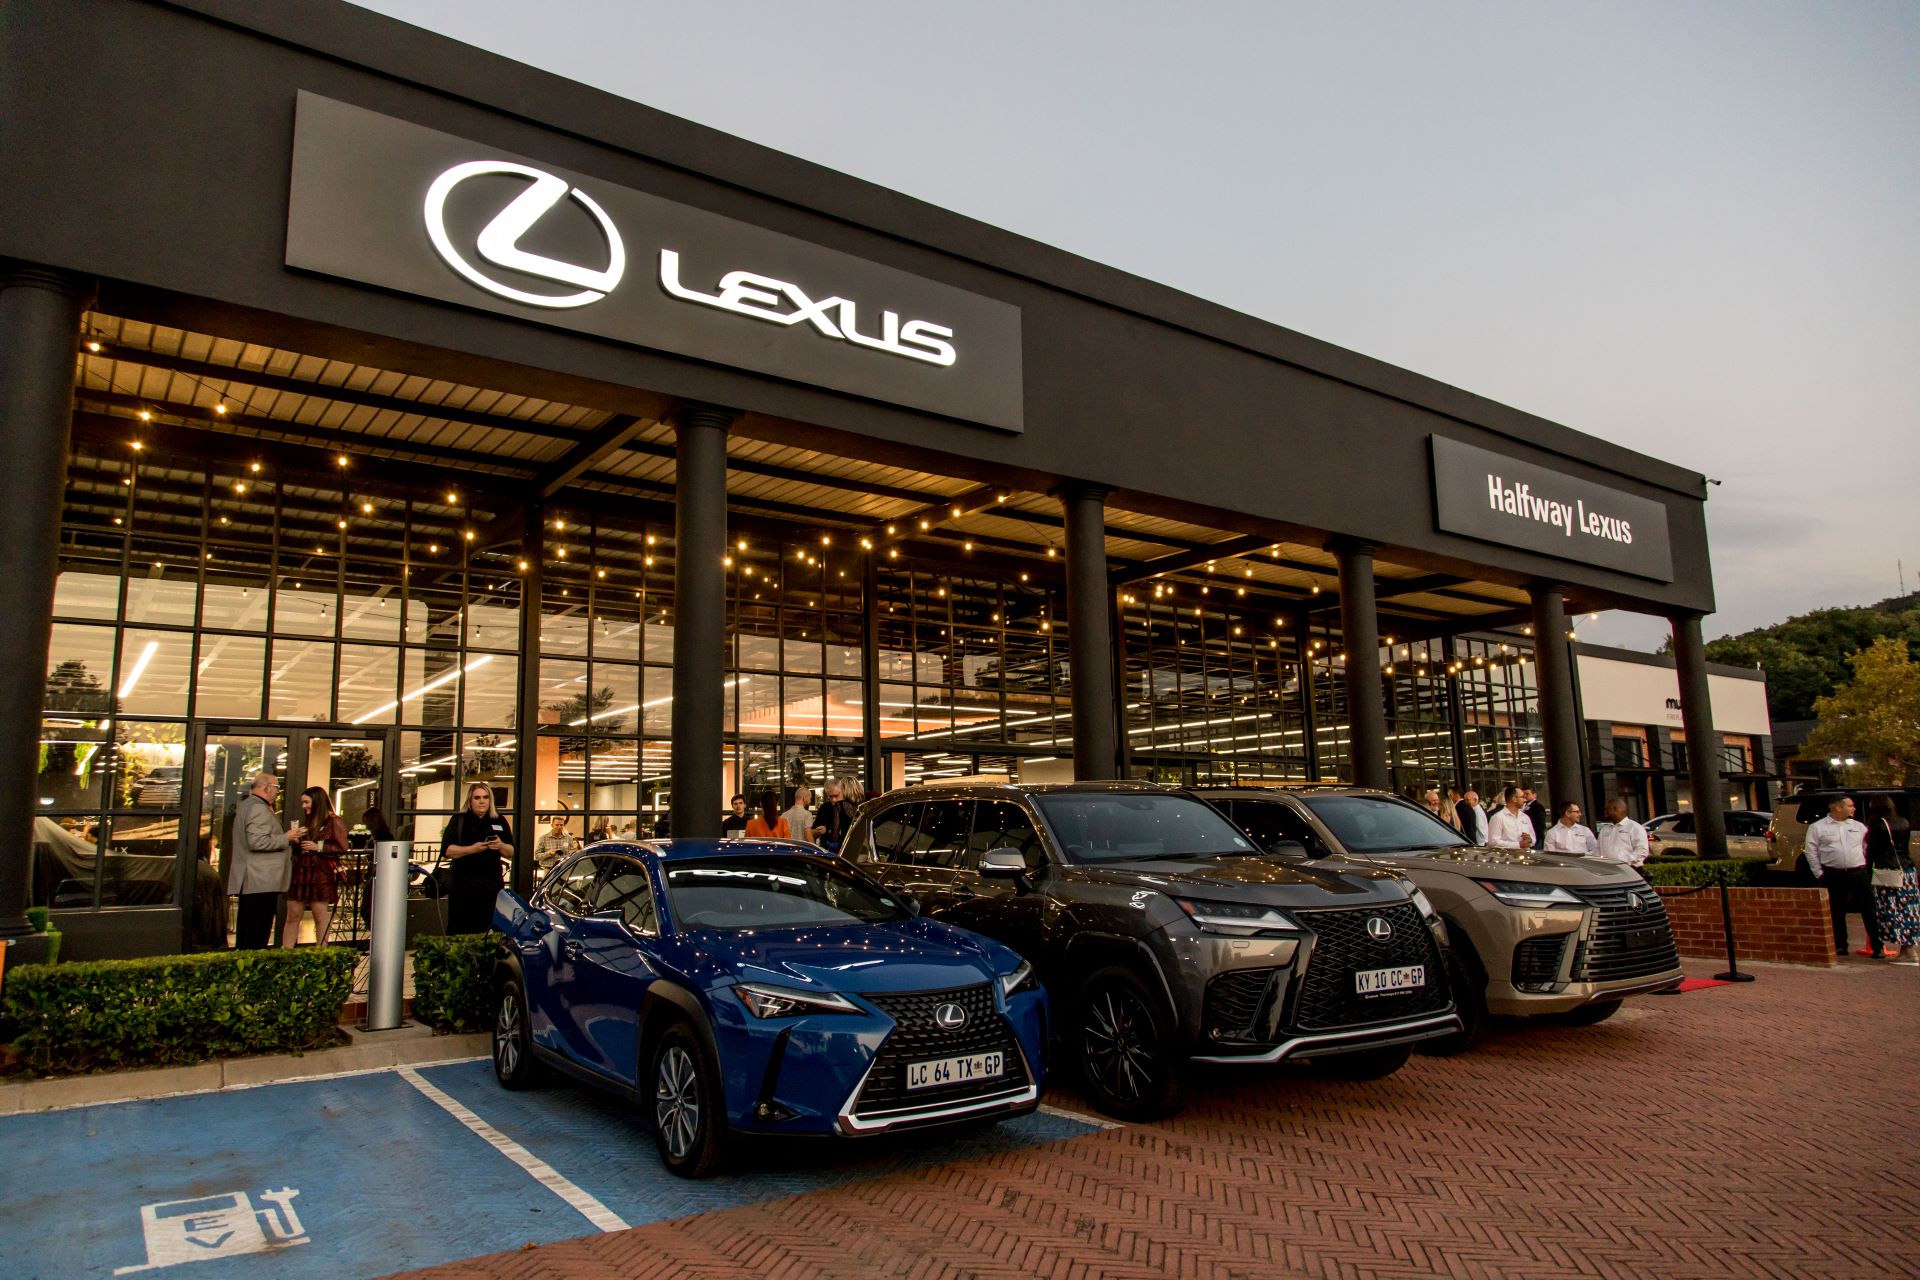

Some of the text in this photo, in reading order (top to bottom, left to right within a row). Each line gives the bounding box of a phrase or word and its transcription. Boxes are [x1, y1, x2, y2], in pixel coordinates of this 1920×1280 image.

[660, 248, 957, 367] LEXUS
[1487, 474, 1633, 544] Halfway Lexus
[1358, 968, 1423, 991] KY 10 CC GP
[911, 1055, 1000, 1086] LC 64 TX GP
